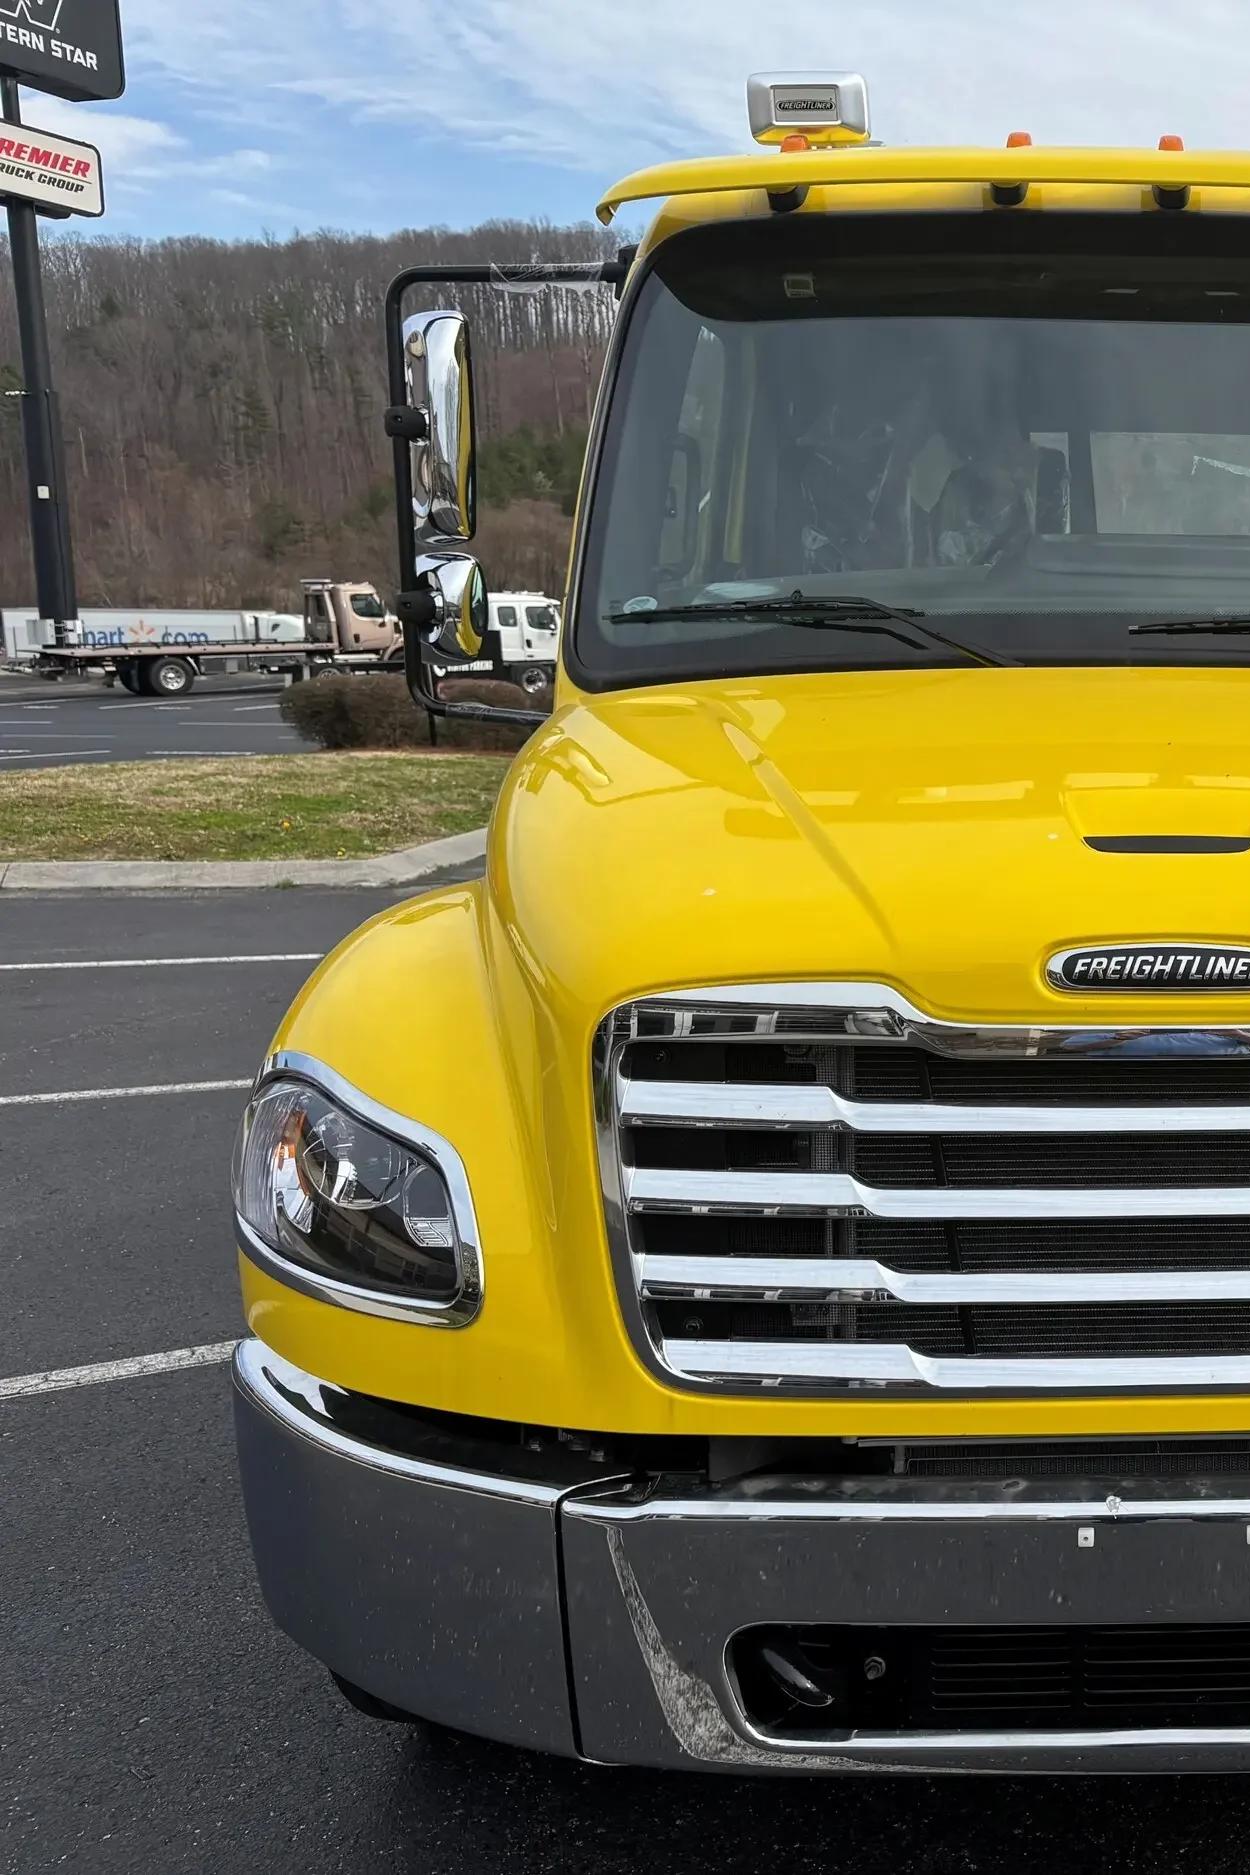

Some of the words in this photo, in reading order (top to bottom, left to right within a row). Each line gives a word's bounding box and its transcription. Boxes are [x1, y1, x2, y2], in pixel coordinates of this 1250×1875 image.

[50, 38, 98, 71] STAR
[780, 101, 831, 110] FREIGHTLINER
[37, 173, 85, 193] GROUP
